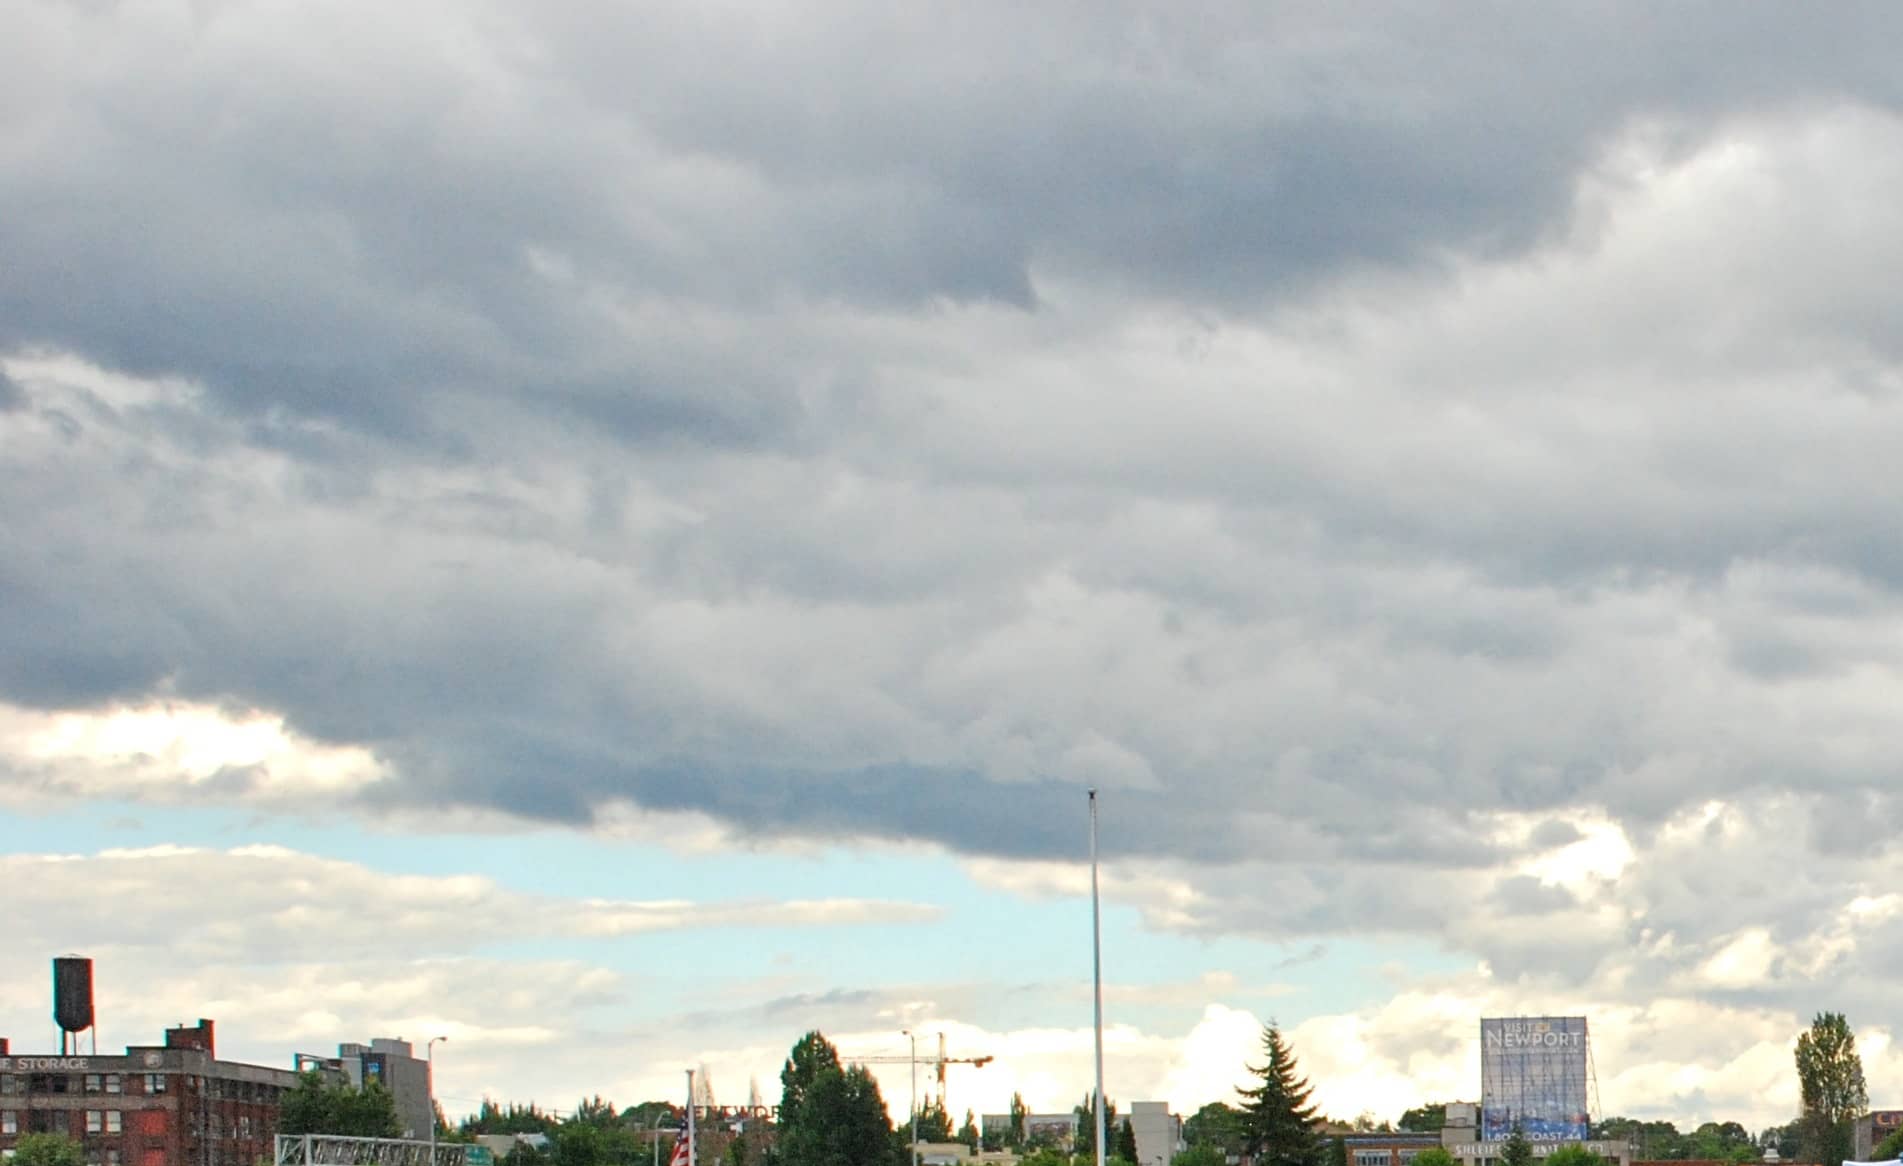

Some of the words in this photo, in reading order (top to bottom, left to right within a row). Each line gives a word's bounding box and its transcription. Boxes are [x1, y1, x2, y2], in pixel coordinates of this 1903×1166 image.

[1503, 1023, 1532, 1033] VISIT
[1486, 1029, 1581, 1048] NEWPORT
[18, 1057, 89, 1070] STORAGE
